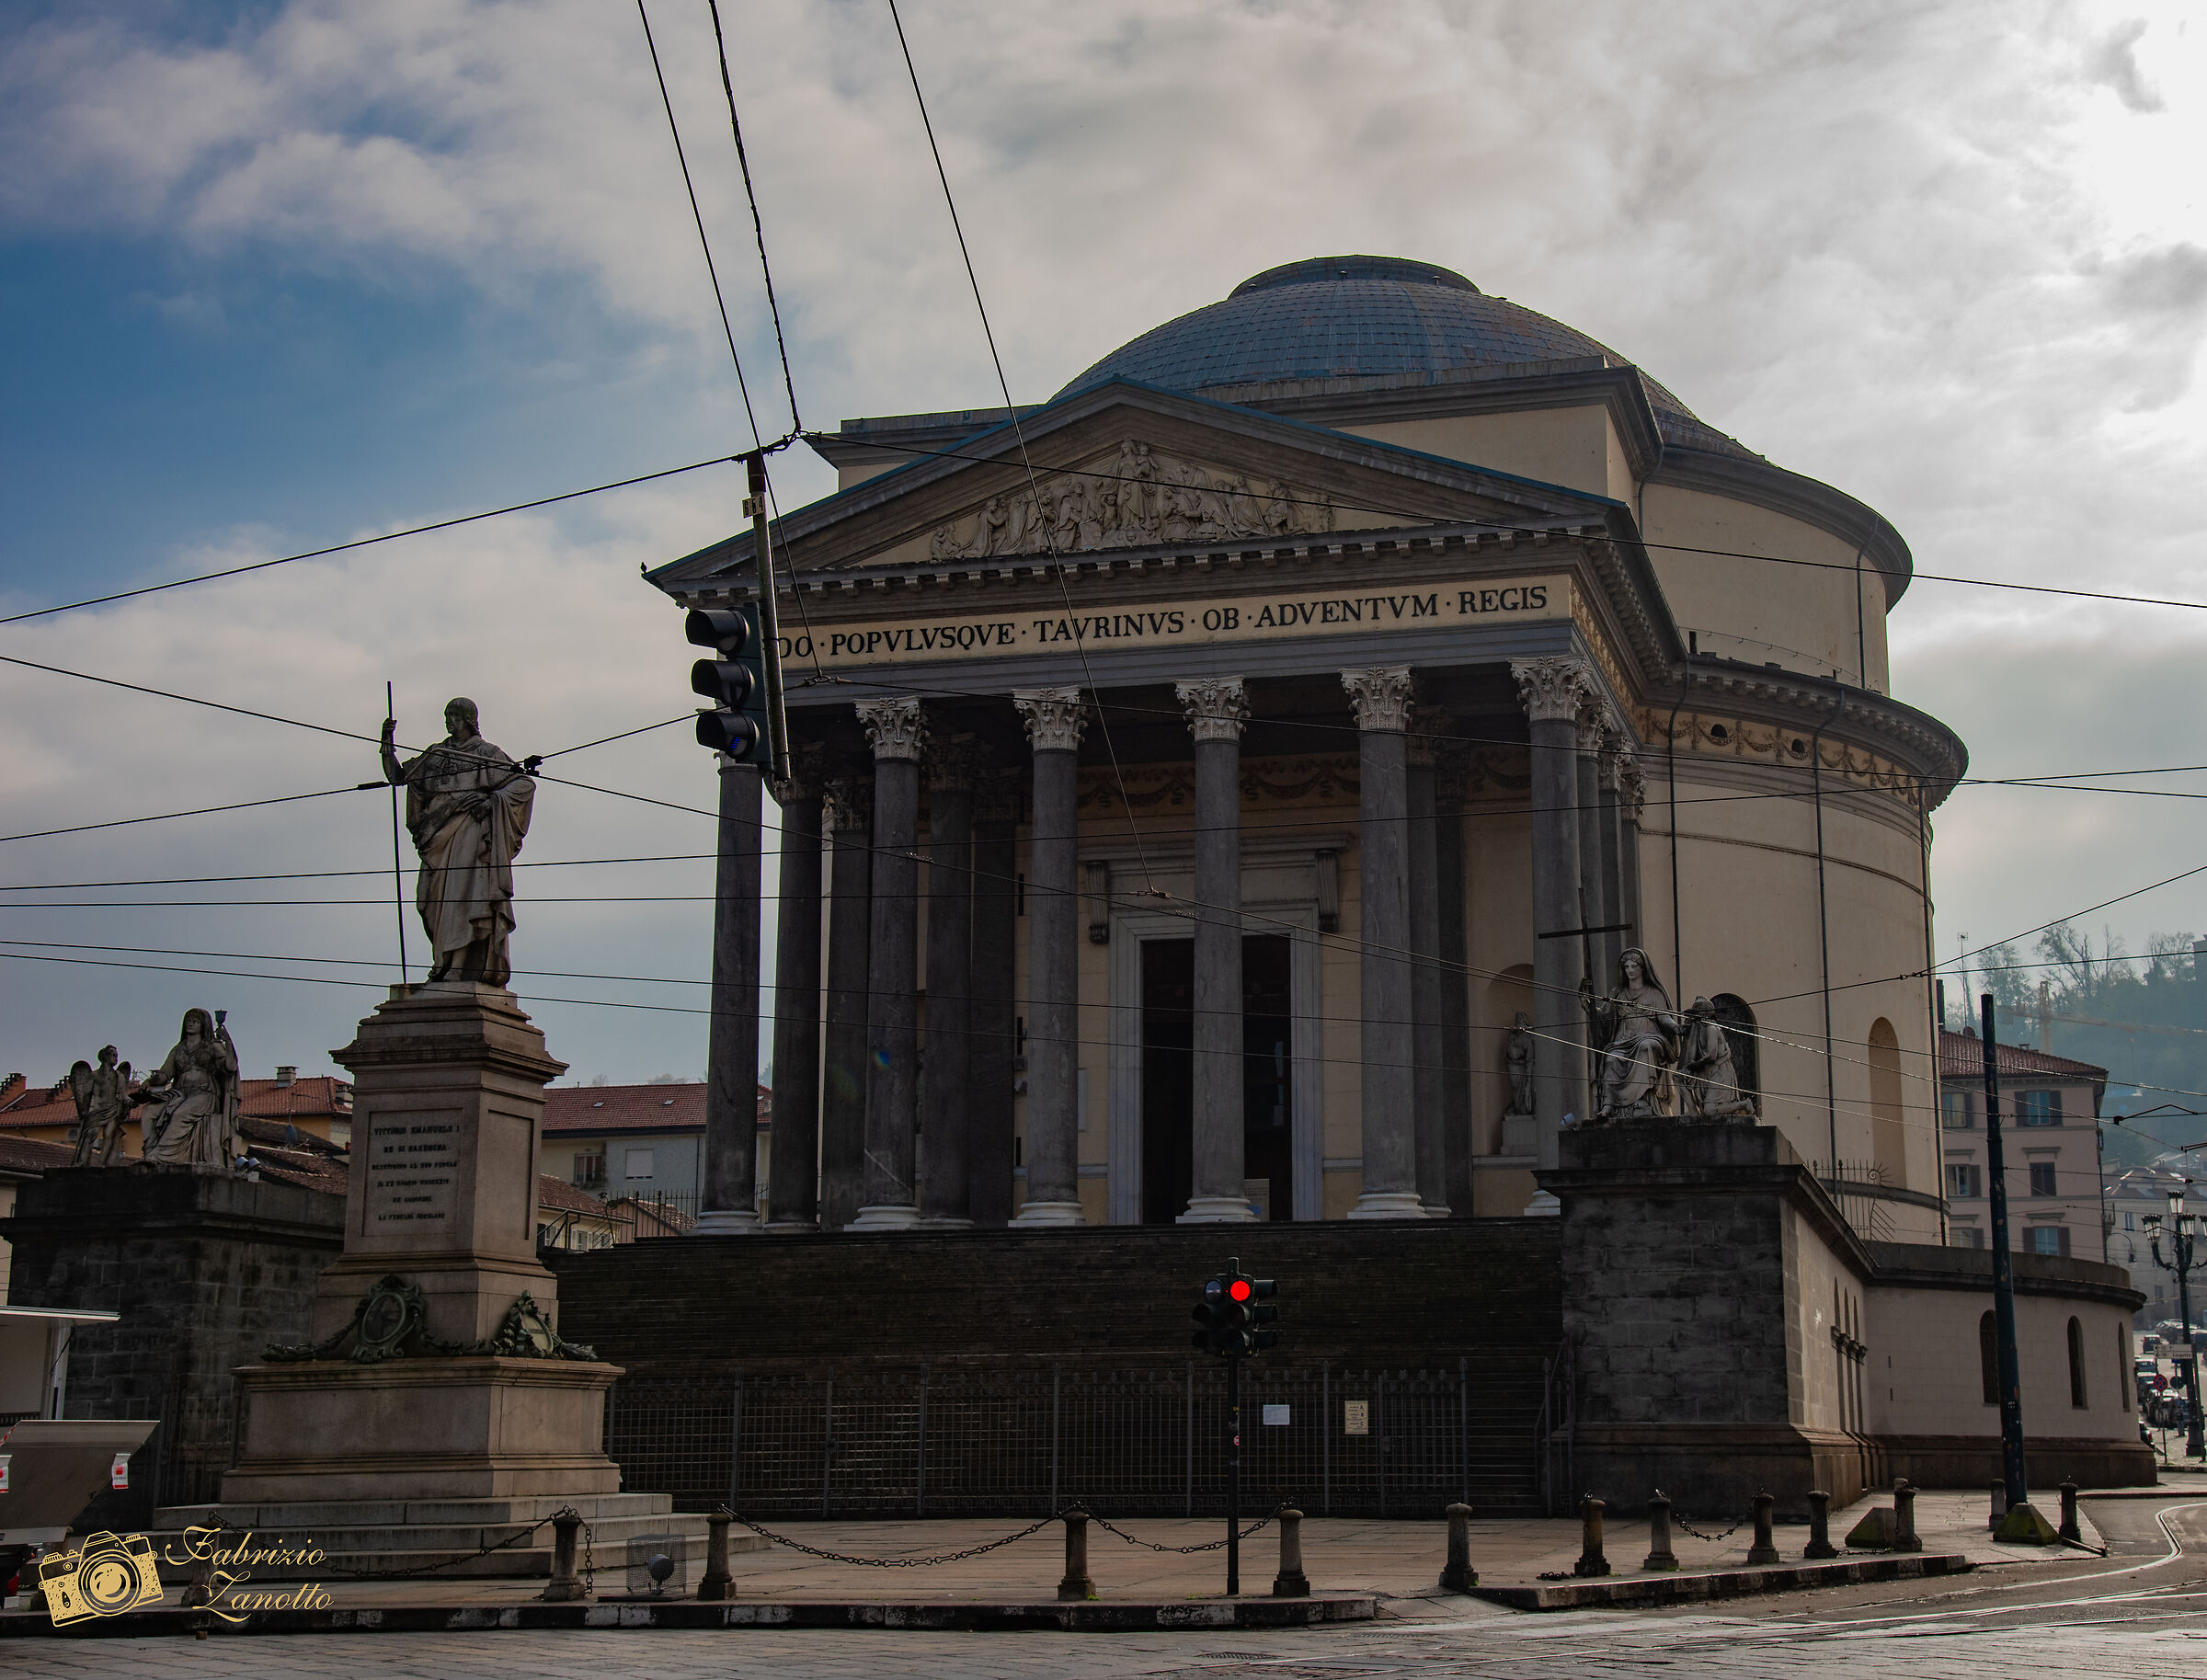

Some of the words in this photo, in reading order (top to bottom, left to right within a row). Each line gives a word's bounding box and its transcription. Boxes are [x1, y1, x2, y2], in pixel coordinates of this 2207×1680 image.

[830, 623, 1015, 657] POPVLVSQVE
[1033, 611, 1185, 643] TAVRINVS
[1202, 607, 1240, 632] OB
[1254, 593, 1438, 629] ADVENTVM
[1458, 585, 1549, 615] REGIS
